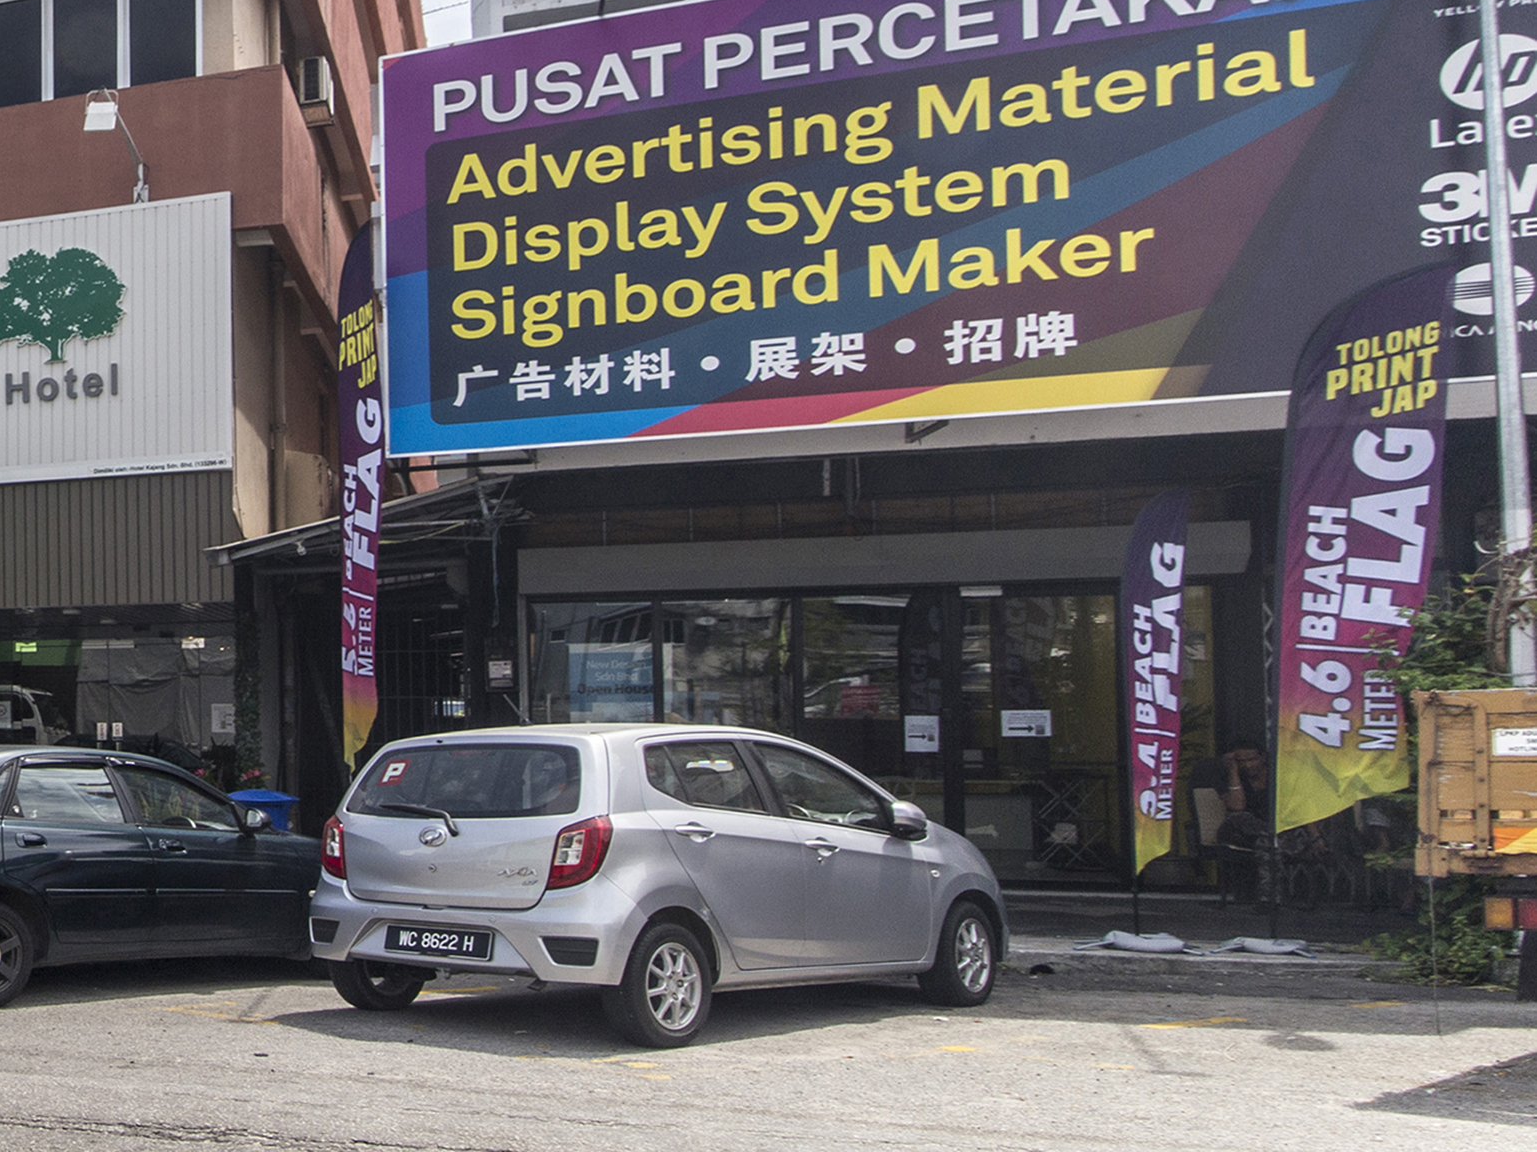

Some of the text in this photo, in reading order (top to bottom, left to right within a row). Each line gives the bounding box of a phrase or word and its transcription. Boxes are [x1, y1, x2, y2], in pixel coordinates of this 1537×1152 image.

[432, 42, 682, 133] PUSAT
[446, 28, 1315, 205] Advertising Material
[1429, 112, 1537, 149] Lae
[452, 158, 1071, 273] Display System
[340, 299, 373, 339] TOLONG
[450, 228, 1155, 348] Signboard Maker
[338, 321, 375, 371] PRINT
[357, 354, 378, 389] JAP
[452, 310, 1078, 407] 广告材料 展架 招牌
[1326, 344, 1440, 402] PRINT
[1336, 320, 1441, 367] TOLONG
[3, 363, 120, 407] Hotel
[1370, 378, 1438, 419] JAP
[343, 397, 383, 581] BEACH FLAG
[1300, 426, 1436, 641] BEACH FLAG
[358, 606, 375, 677] METER
[1133, 541, 1185, 726] BEACH FLAG
[577, 683, 612, 696] Open
[1298, 659, 1352, 749] 4.6
[381, 762, 406, 783] P
[1155, 748, 1173, 821] METER
[399, 930, 475, 952] WC 8622 H
